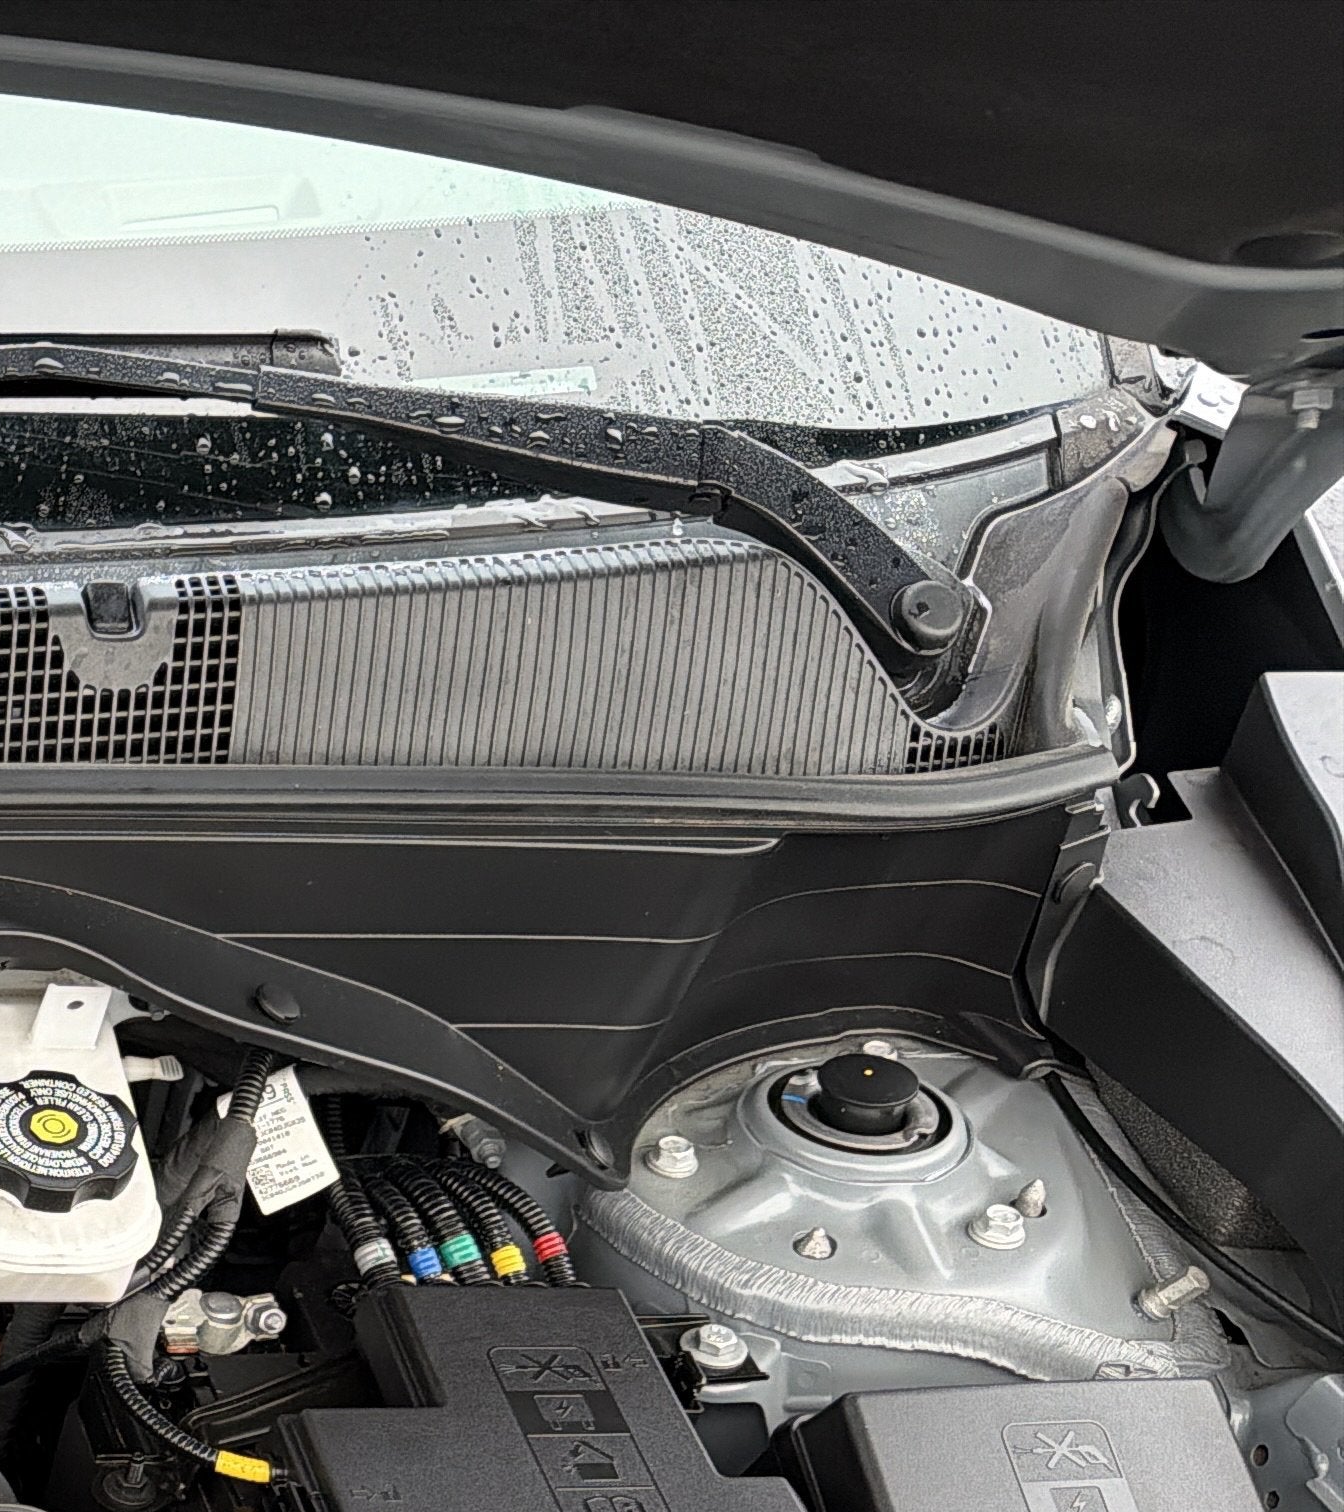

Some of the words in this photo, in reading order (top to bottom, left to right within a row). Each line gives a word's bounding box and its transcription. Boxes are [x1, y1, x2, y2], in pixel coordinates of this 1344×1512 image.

[26, 1087, 52, 1097] ONLY
[32, 1096, 68, 1107] FILLER
[75, 1085, 110, 1108] SEALED
[65, 1101, 95, 1121] CLEAN
[105, 1110, 125, 1130] FROM
[97, 1122, 112, 1149] BEFORE
